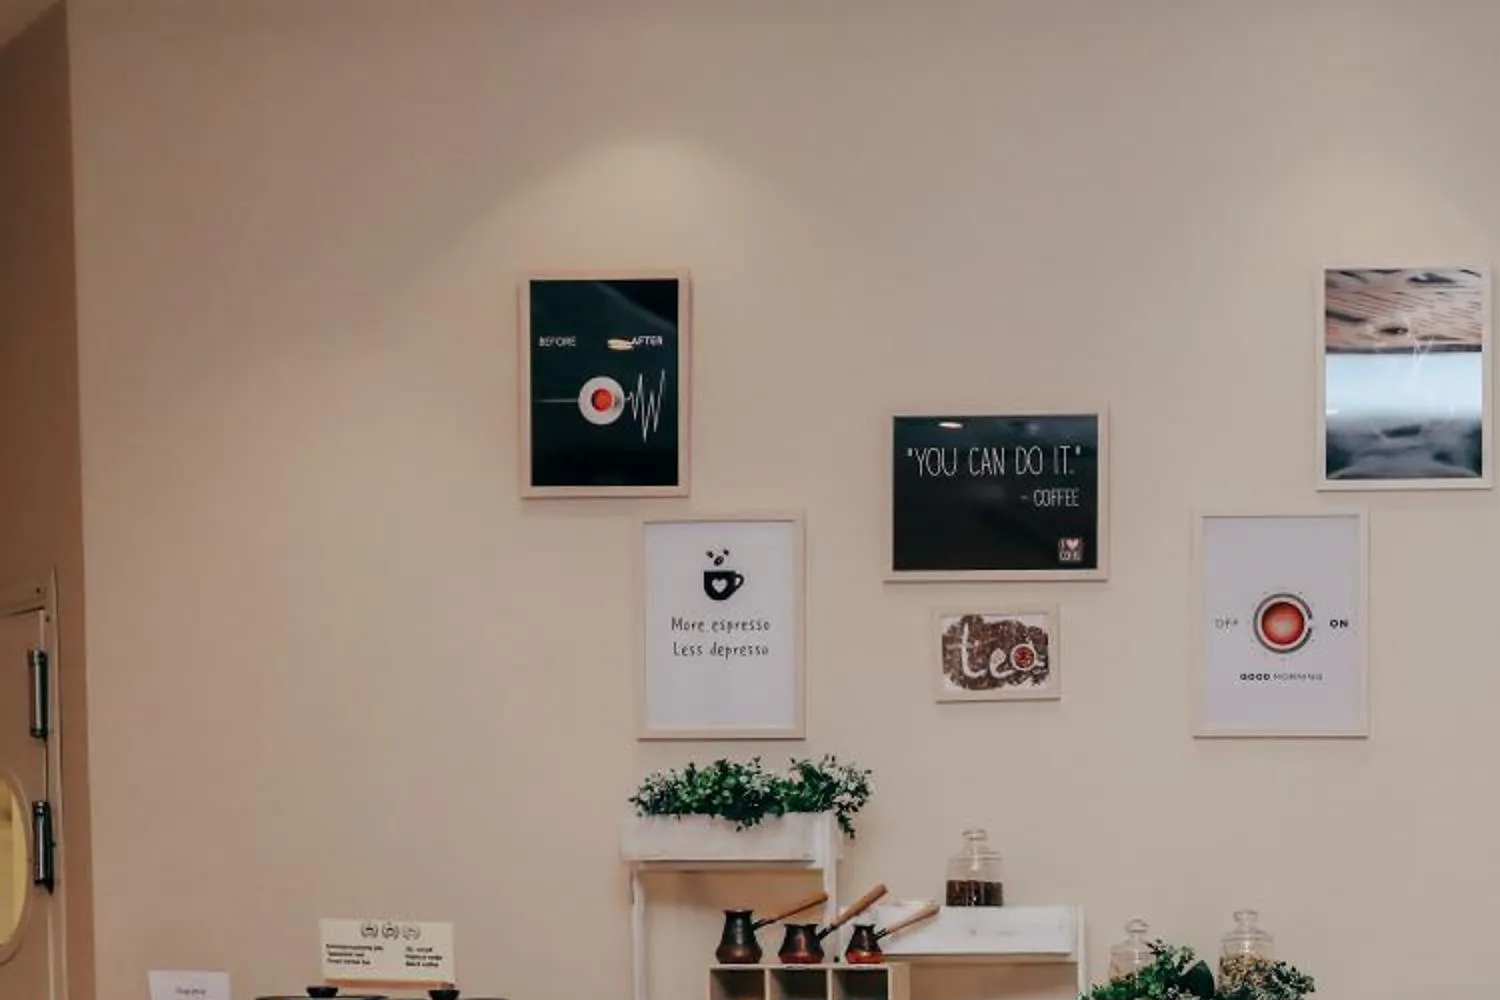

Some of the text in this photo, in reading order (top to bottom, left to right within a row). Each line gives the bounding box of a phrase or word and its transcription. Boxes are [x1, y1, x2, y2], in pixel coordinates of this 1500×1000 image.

[538, 334, 577, 348] BEFORE
[631, 334, 663, 346] AFTER
[968, 446, 1006, 477] CAN
[1014, 445, 1044, 476] DO
[1032, 487, 1080, 507] COFFEE
[670, 616, 771, 634] More espresso
[1329, 618, 1349, 629] ON
[672, 641, 770, 660] Less depresso
